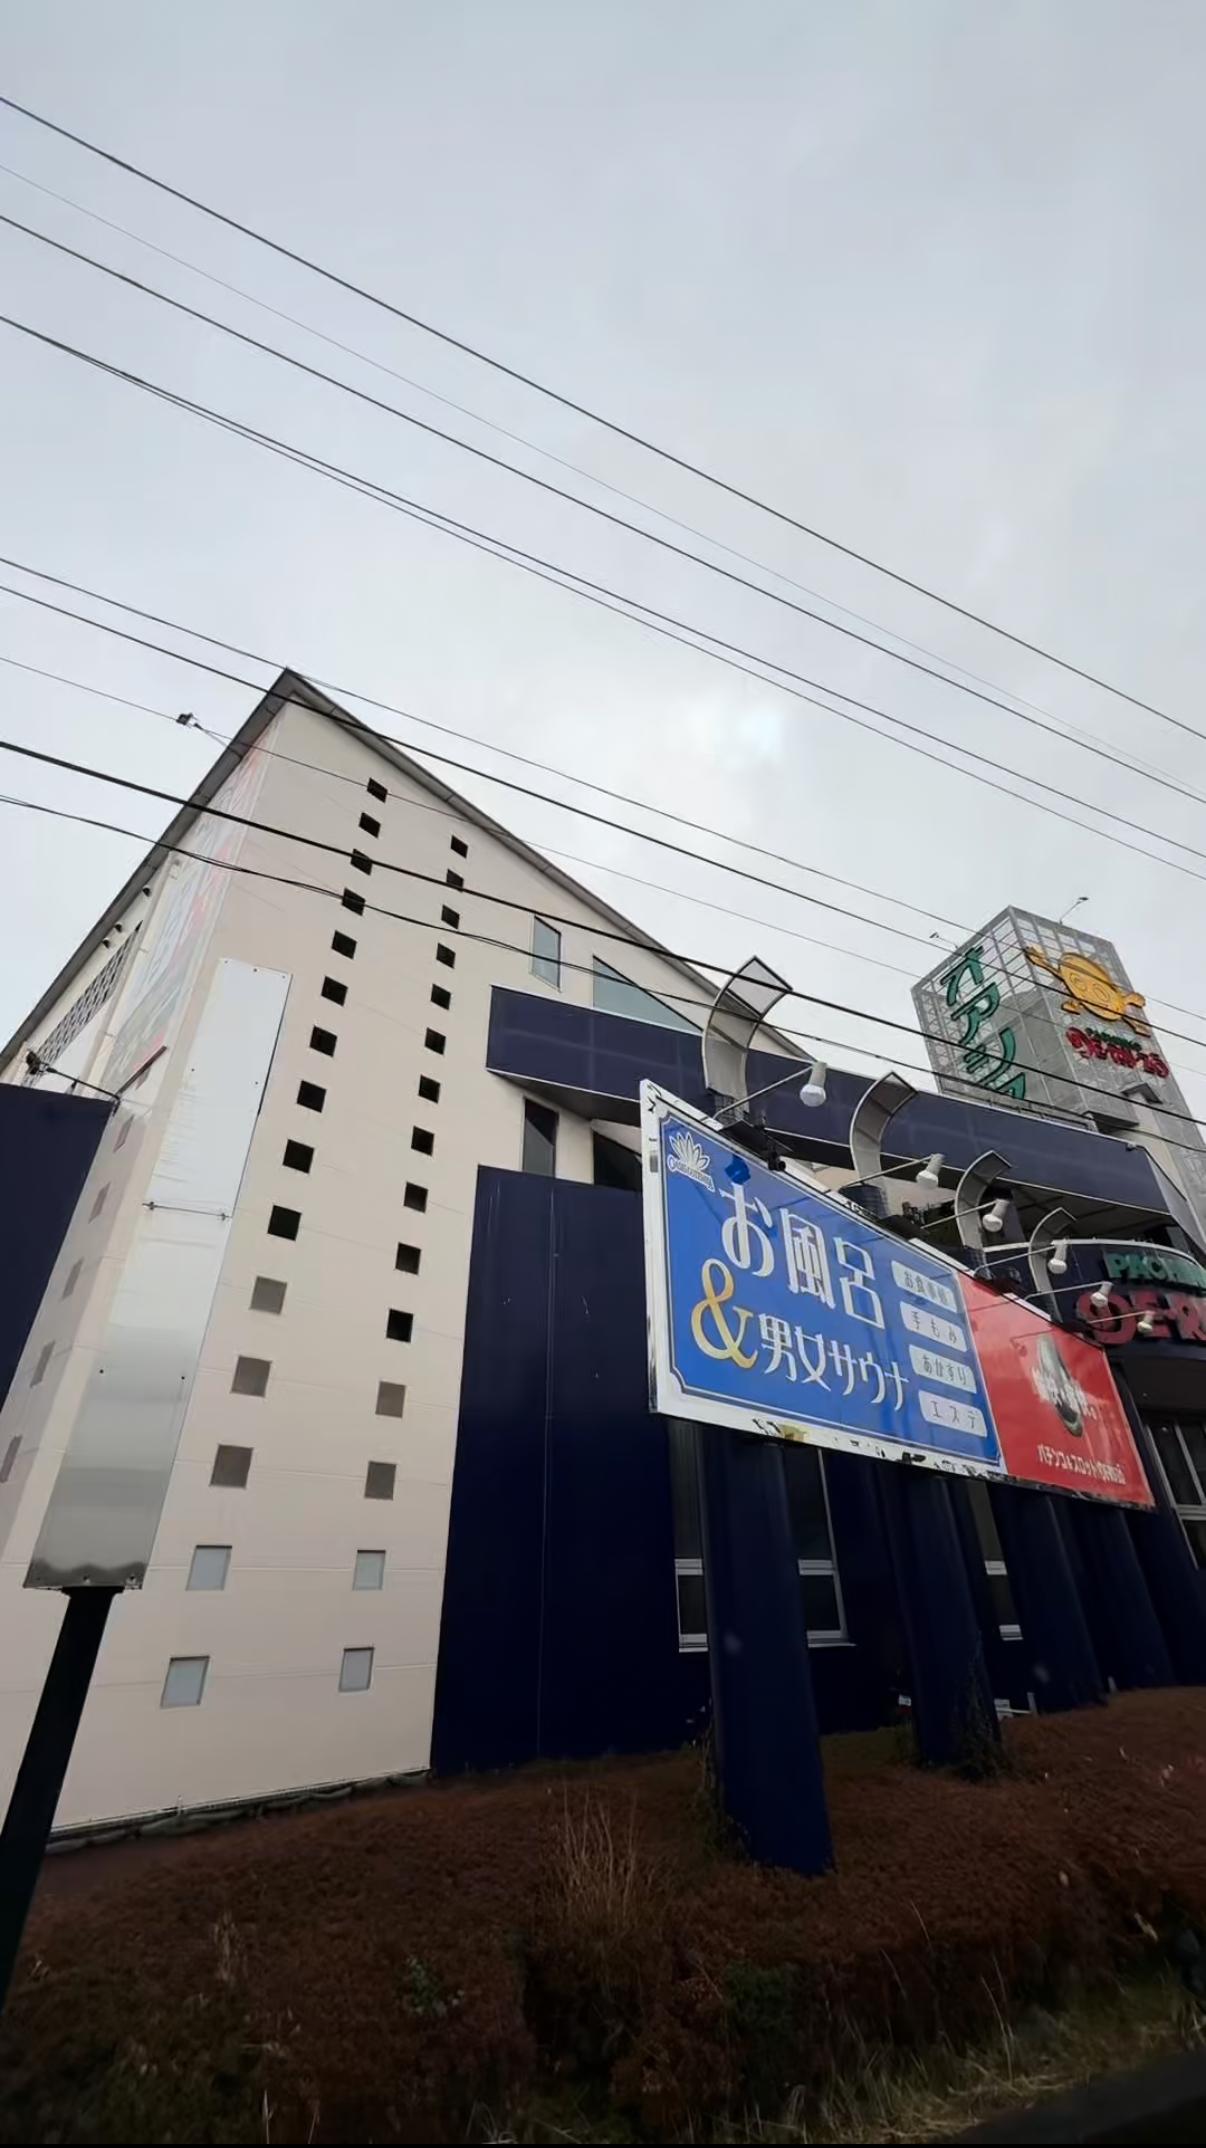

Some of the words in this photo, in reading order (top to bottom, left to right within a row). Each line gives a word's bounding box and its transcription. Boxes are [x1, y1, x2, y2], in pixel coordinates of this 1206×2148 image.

[718, 1183, 886, 1330] お風呂
[758, 1313, 909, 1412] 男女サウナ
[930, 1400, 979, 1430] エステ
